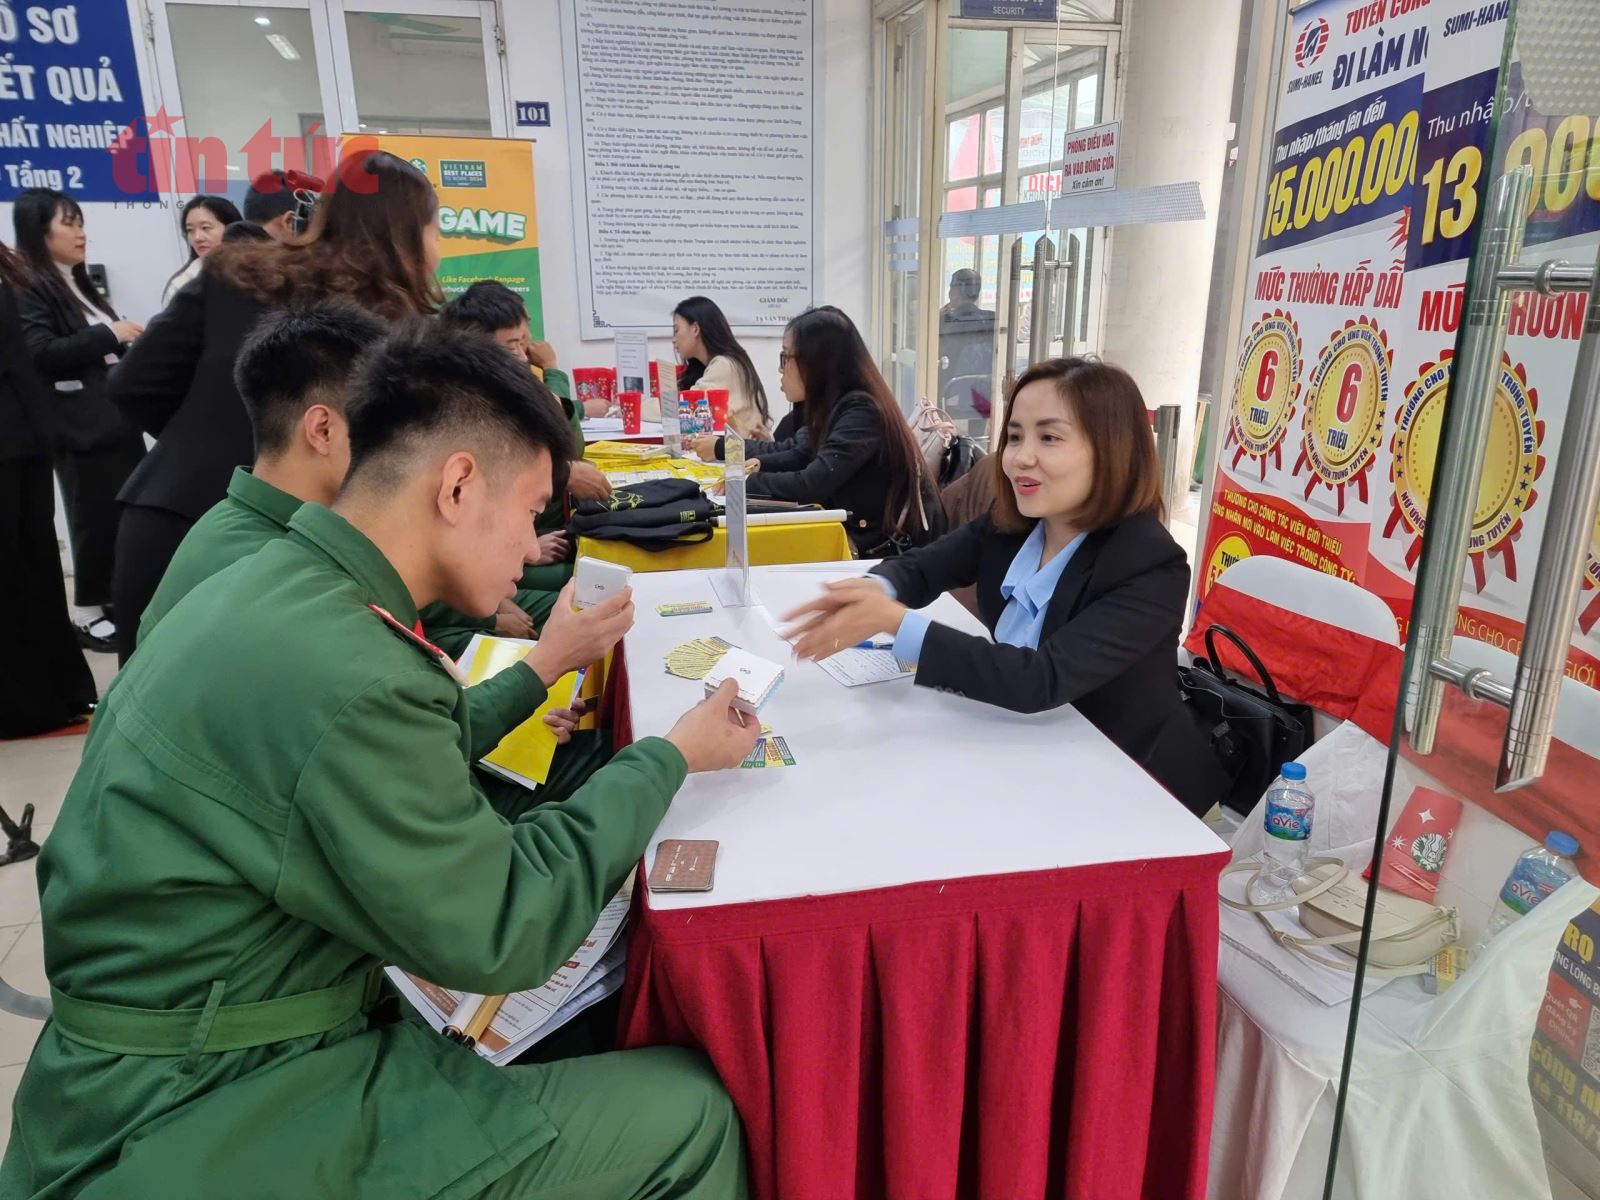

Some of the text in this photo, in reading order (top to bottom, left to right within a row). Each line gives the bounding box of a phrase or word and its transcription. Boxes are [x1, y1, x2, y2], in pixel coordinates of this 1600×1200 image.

[26, 5, 80, 45] SƠ
[992, 6, 1026, 16] SECURITY
[1443, 0, 1510, 38] SUMI-HANE
[1331, 50, 1356, 91] ĐI
[1356, 26, 1406, 83] LÀM
[0, 52, 124, 106] ẾT QUẢ
[518, 106, 548, 121] 101
[1275, 95, 1388, 164] Thu nhập/tháng lên đến
[1428, 116, 1456, 141] Thu
[45, 119, 135, 154] NGHIỆP
[1067, 131, 1115, 155] PHÒNG ĐIỀU HÒA
[5, 160, 84, 191] Tầng 2
[443, 163, 483, 171] VIETNAM
[1064, 154, 1115, 178] RA VÀO ĐÓNG CỬA
[1072, 179, 1082, 190] Xin
[1082, 177, 1094, 189] cảm
[1262, 110, 1420, 241] 15.000.00
[439, 206, 528, 242] GAME
[442, 275, 457, 283] Like
[494, 276, 526, 284] Fanpage
[1255, 265, 1286, 302] MỨC
[1287, 263, 1340, 305] THƯỞNG
[1339, 259, 1375, 307] HẤP
[1333, 336, 1346, 353] CHO
[1256, 350, 1279, 402] 6
[1336, 363, 1363, 423] 6
[1250, 407, 1270, 427] TRIỆU
[1400, 385, 1426, 432] THƯỞNG
[1423, 368, 1445, 390] CHO
[1519, 410, 1534, 455] TUYỂN
[1327, 428, 1349, 452] TRIỆU
[1224, 488, 1248, 510] THƯỞNG
[1247, 499, 1258, 514] CHO
[1277, 511, 1289, 530] TÁC
[1289, 518, 1305, 537] VIÊN
[1306, 526, 1321, 545] GIỚI
[1321, 533, 1343, 557] THIỆU
[1225, 508, 1243, 526] NHÂN
[1243, 515, 1253, 533] MỚI
[1253, 519, 1265, 539] VÀO
[1265, 526, 1280, 547] LÀM
[1280, 536, 1295, 555] VIỆC
[1296, 544, 1319, 568] TRONG
[1318, 556, 1338, 577] CÔNG
[1478, 623, 1505, 650] CHO
[1569, 963, 1593, 990] LONG
[1530, 1038, 1577, 1096] Công
